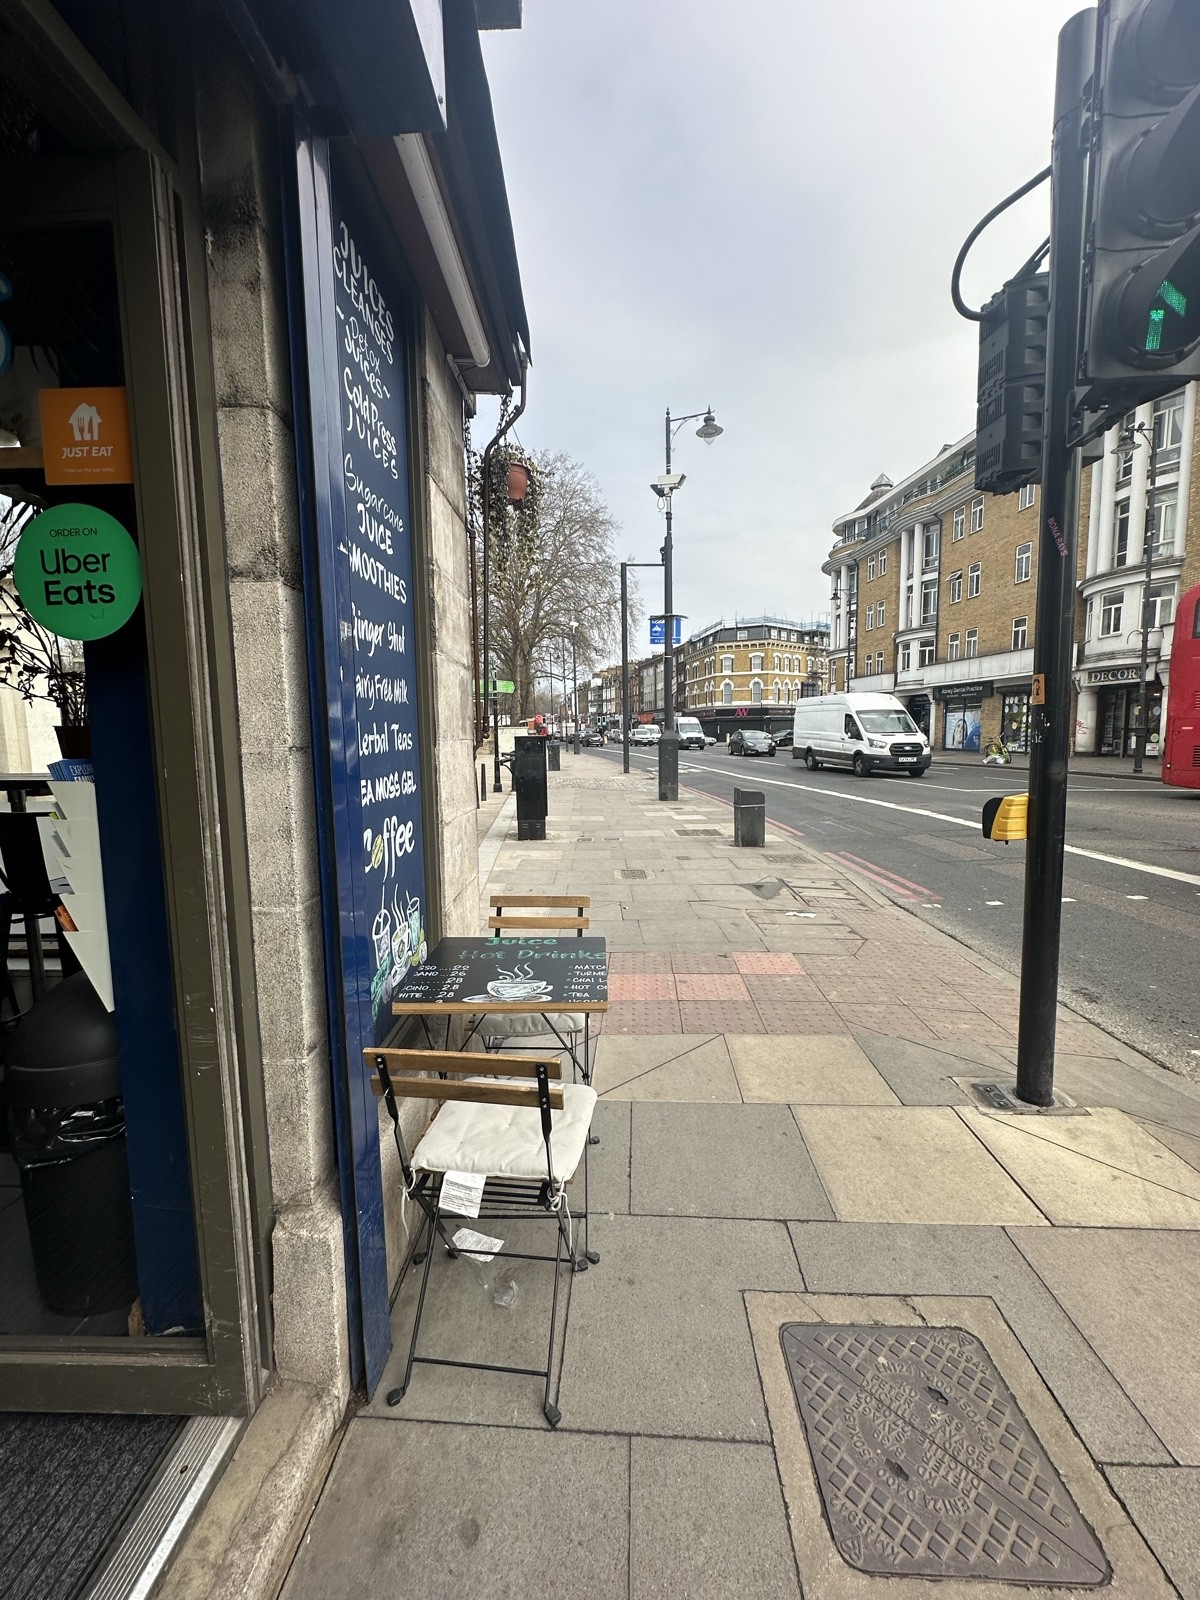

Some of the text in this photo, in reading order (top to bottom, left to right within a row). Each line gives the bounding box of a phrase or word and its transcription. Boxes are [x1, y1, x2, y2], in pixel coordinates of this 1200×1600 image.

[340, 220, 394, 341] JUICES
[334, 246, 393, 364] CLEANSES
[350, 316, 381, 376] Detox
[344, 367, 397, 455] Cold Press
[62, 446, 114, 459] JUST EAT
[346, 404, 398, 480] JUICES
[344, 453, 404, 532] Sugarcane
[49, 527, 98, 538] ORDER ON
[357, 503, 393, 554] JUICE
[40, 548, 111, 575] Uber
[43, 579, 116, 606] Eats
[356, 667, 409, 711] airy Free Milk
[1091, 668, 1137, 682] DECOR
[391, 723, 413, 751] Teas
[360, 770, 417, 807] EA MOSS GEL
[459, 949, 608, 960] Hot Drinks
[484, 937, 558, 946] Juice
[928, 1330, 990, 1376] KM45942
[859, 1376, 919, 1426] DUCTILE
[869, 1372, 989, 1467] PETER SAVAGE
[851, 1396, 973, 1499] PETER SAVAGE
[914, 1432, 982, 1491] DUCTILE
[876, 1467, 914, 1502] D400
[922, 1494, 969, 1514] EN124
[827, 1490, 901, 1566] KM45942
